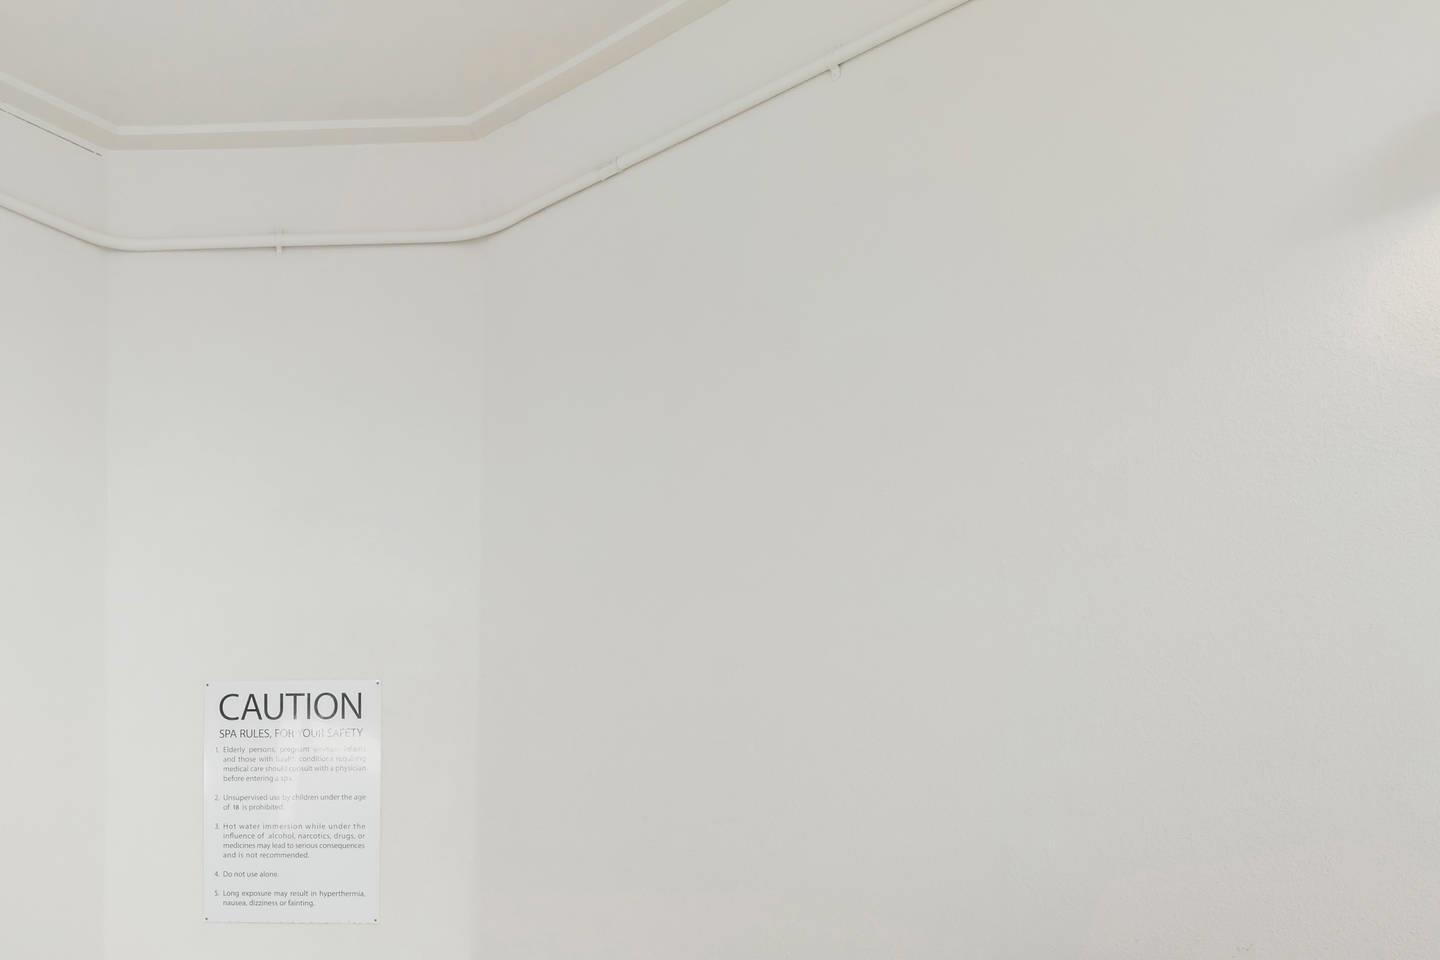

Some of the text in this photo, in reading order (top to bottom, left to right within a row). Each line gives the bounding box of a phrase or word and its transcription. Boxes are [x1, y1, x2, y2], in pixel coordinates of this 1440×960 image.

[219, 692, 362, 720] CAUTION
[219, 729, 237, 738] SPA
[240, 729, 272, 739] RULES,
[275, 728, 295, 738] FOR
[327, 728, 363, 738] SAFETY
[223, 746, 245, 754] Elderly
[336, 765, 366, 773] physician
[246, 775, 273, 783] entering
[223, 794, 268, 802] Unsupervised
[269, 832, 296, 840] alcohol,
[334, 833, 356, 841] drugs,
[223, 890, 240, 898] Long
[319, 890, 365, 898] hyperthermia,
[288, 899, 315, 908] fainting.
